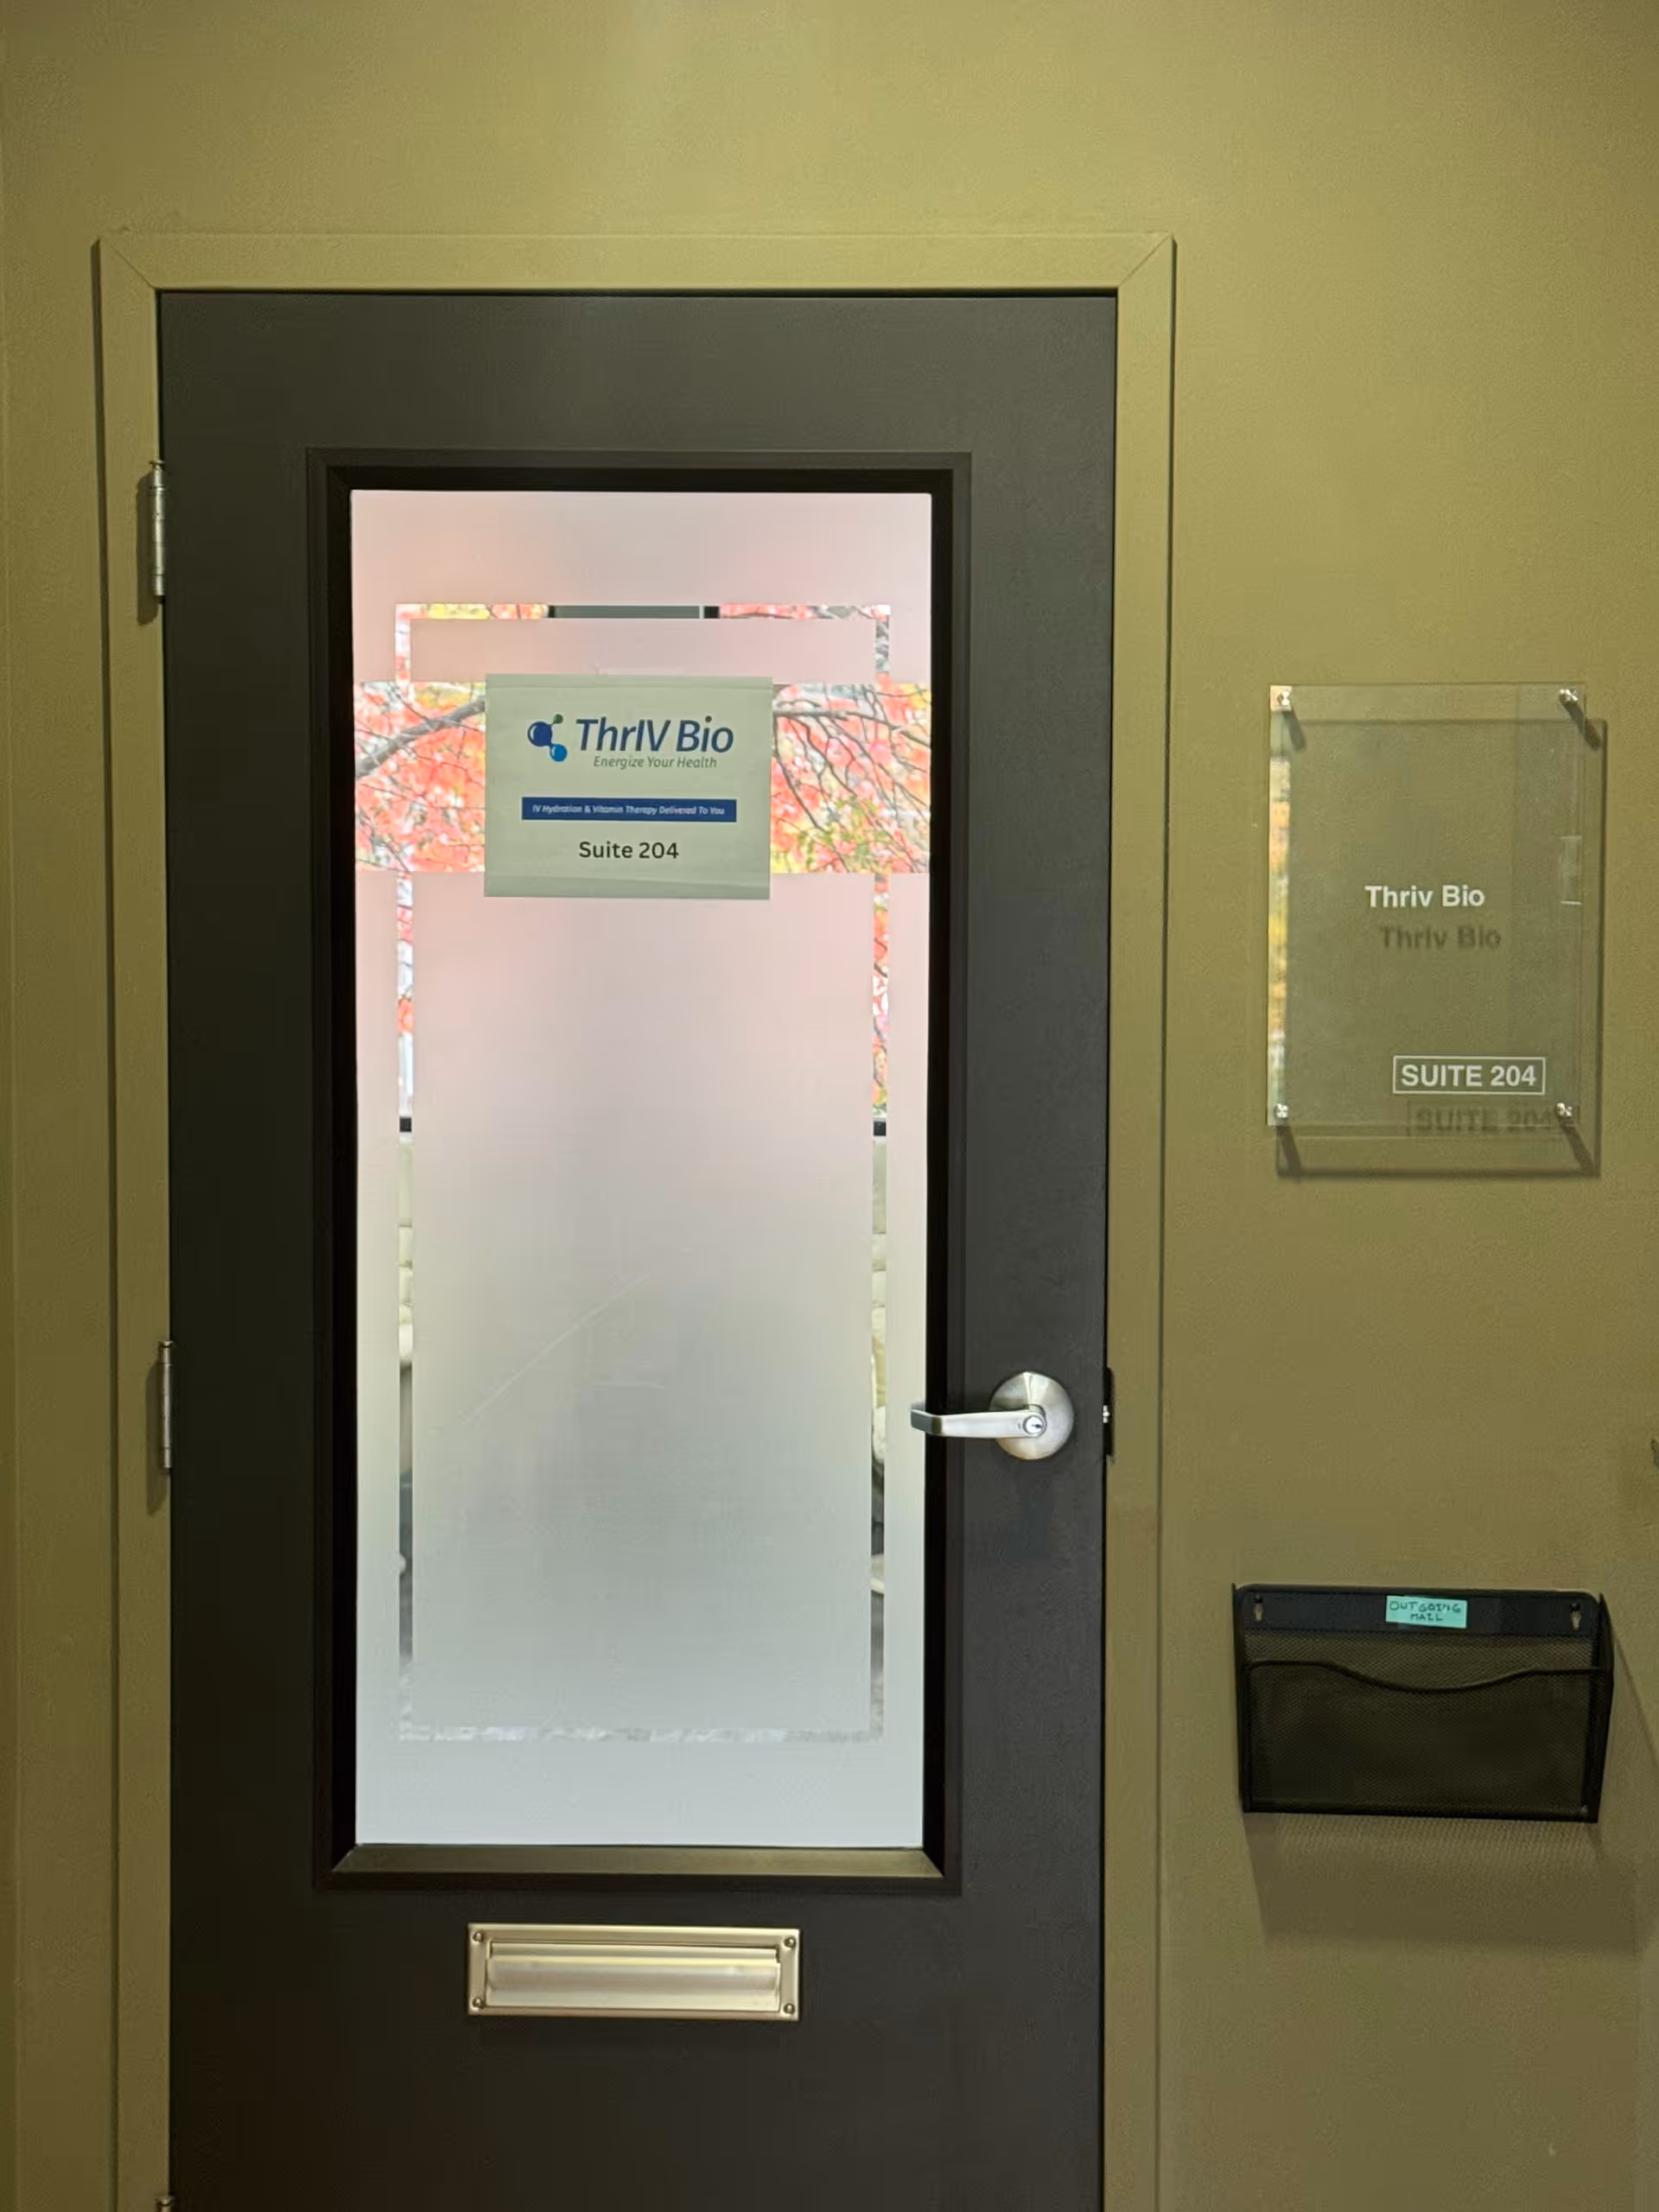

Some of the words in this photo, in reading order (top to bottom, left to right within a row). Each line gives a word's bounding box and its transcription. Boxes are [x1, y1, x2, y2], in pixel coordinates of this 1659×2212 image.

[575, 716, 671, 752] ThrIV
[676, 715, 734, 753] Bio
[594, 755, 644, 770] Energize
[647, 757, 674, 768] Your
[677, 756, 717, 768] Health
[542, 804, 582, 815] Hydration
[583, 805, 591, 814] &
[593, 805, 624, 814] Vitamin
[626, 805, 657, 816] Therapy
[659, 806, 696, 815] Delivered
[699, 806, 708, 815] To
[709, 806, 725, 816] You
[579, 840, 633, 859] Suite
[639, 842, 679, 859] 204
[1364, 885, 1434, 908] Thriv
[1441, 884, 1486, 907] Bio
[1401, 1064, 1483, 1087] SUITE
[1490, 1065, 1536, 1087] 204
[1410, 1612, 1444, 1622] MAIL
